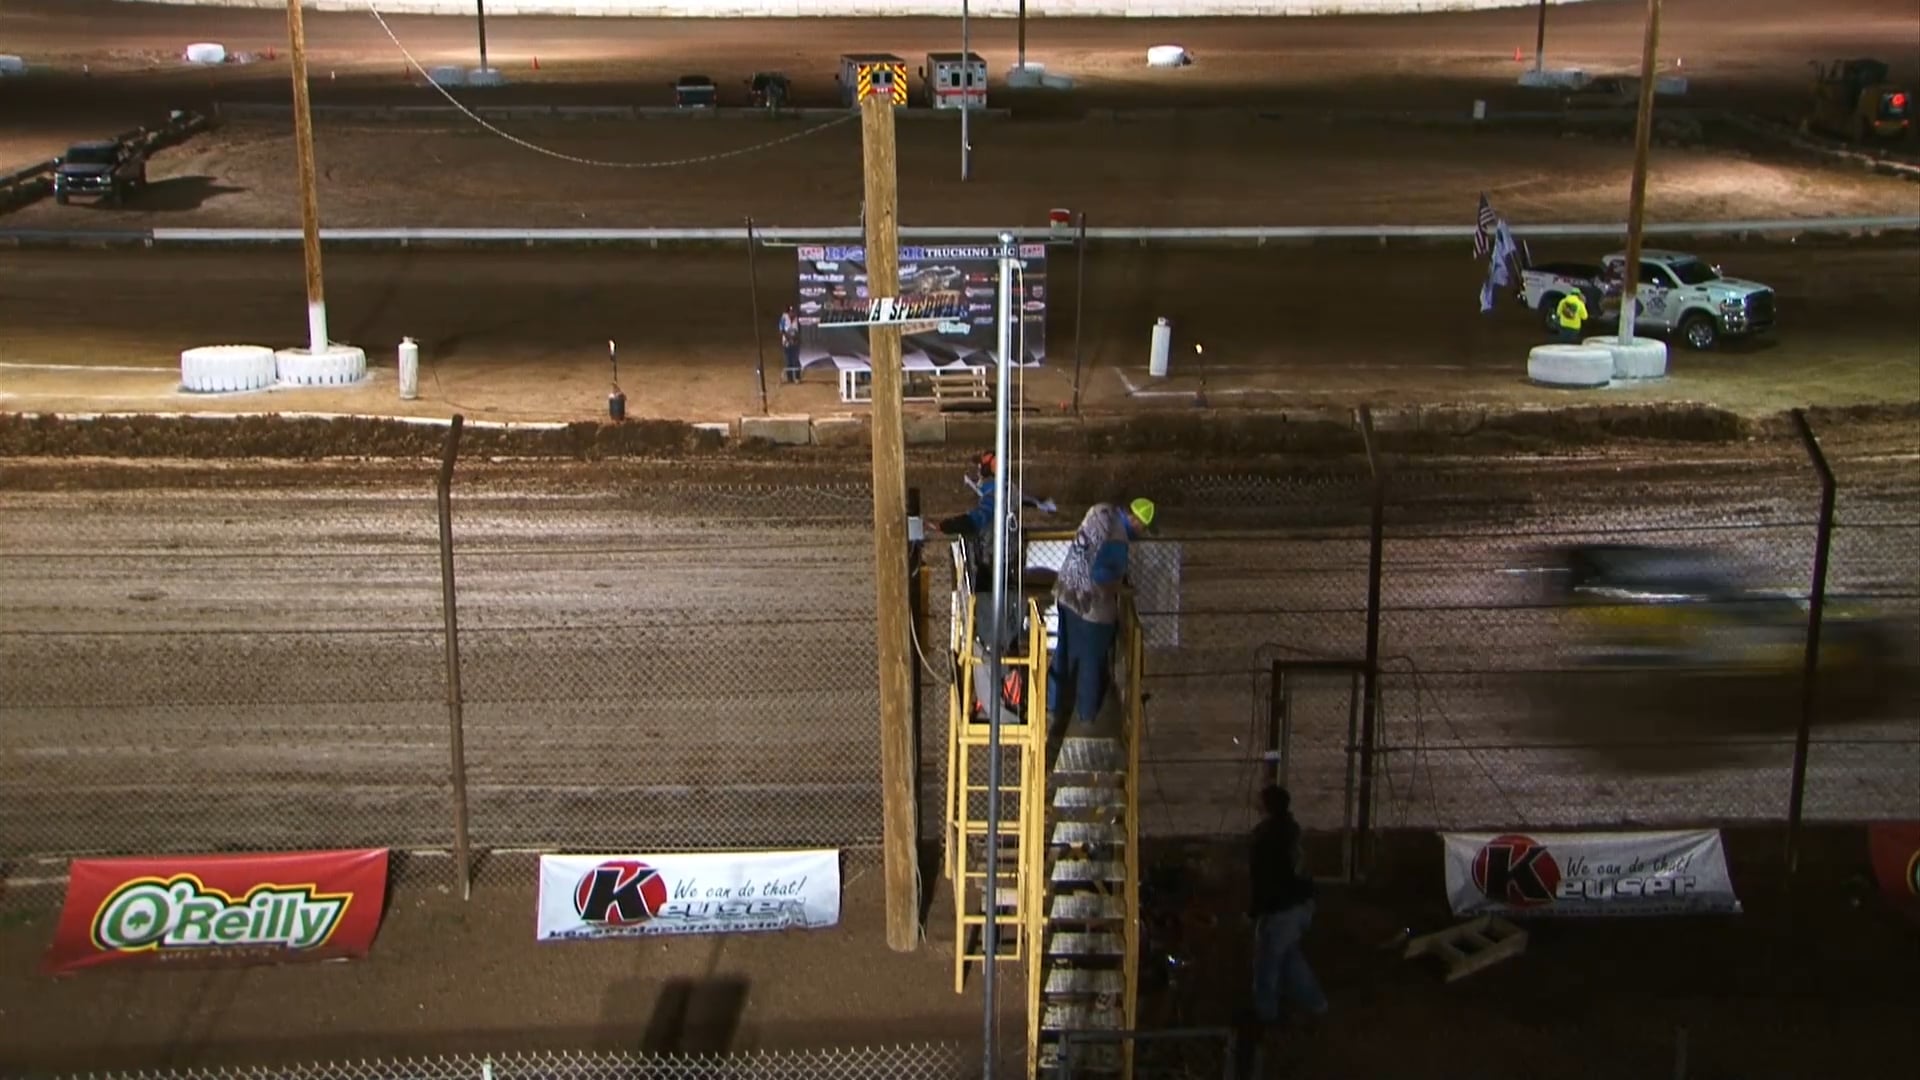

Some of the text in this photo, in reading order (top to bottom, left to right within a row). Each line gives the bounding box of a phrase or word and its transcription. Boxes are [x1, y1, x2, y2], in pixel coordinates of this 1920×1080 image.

[926, 247, 989, 258] TRUCKING
[1566, 853, 1693, 877] We can do that!
[674, 875, 807, 899] We can do that!
[100, 881, 341, 948] O'Reilly
